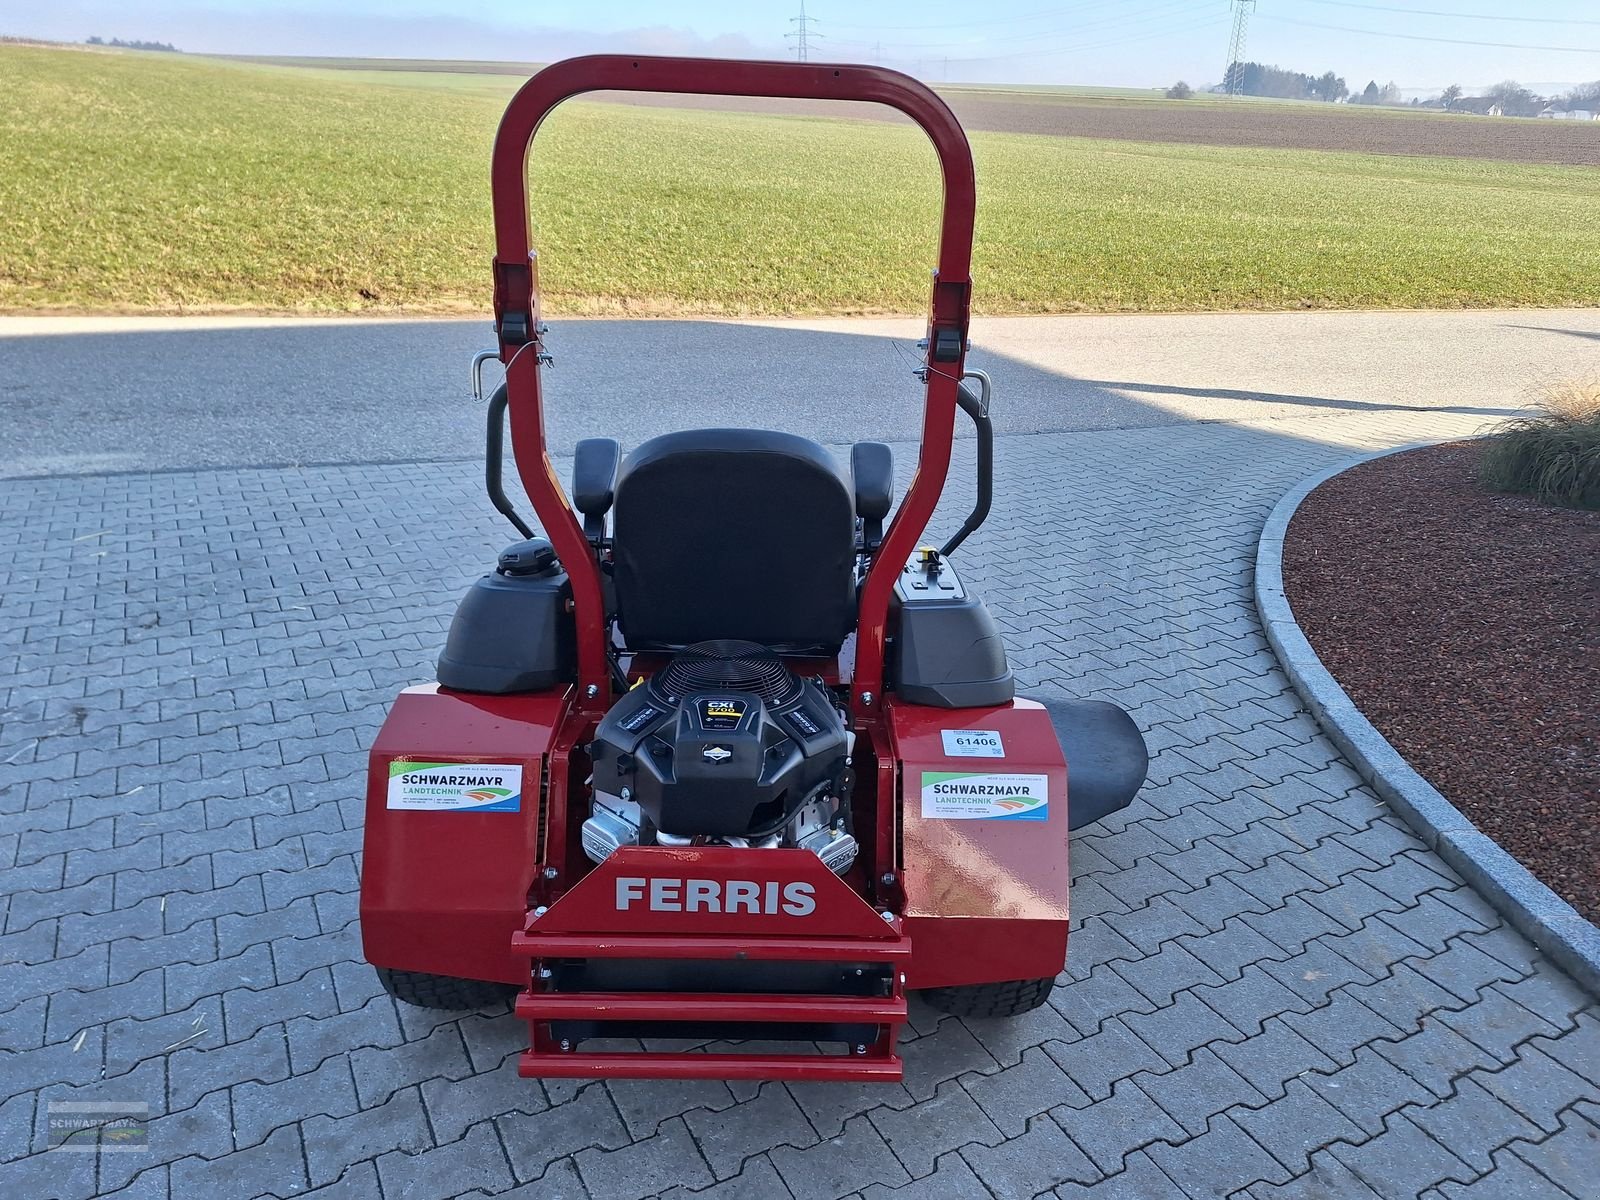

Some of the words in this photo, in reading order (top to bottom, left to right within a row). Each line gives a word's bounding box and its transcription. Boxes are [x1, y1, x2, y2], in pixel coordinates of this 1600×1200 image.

[402, 775, 503, 786] SCHWARZMAYR
[934, 785, 1030, 795] SCHWARZMAYR
[935, 797, 992, 805] LANDTECHNIK
[616, 877, 816, 916] FERRIS
